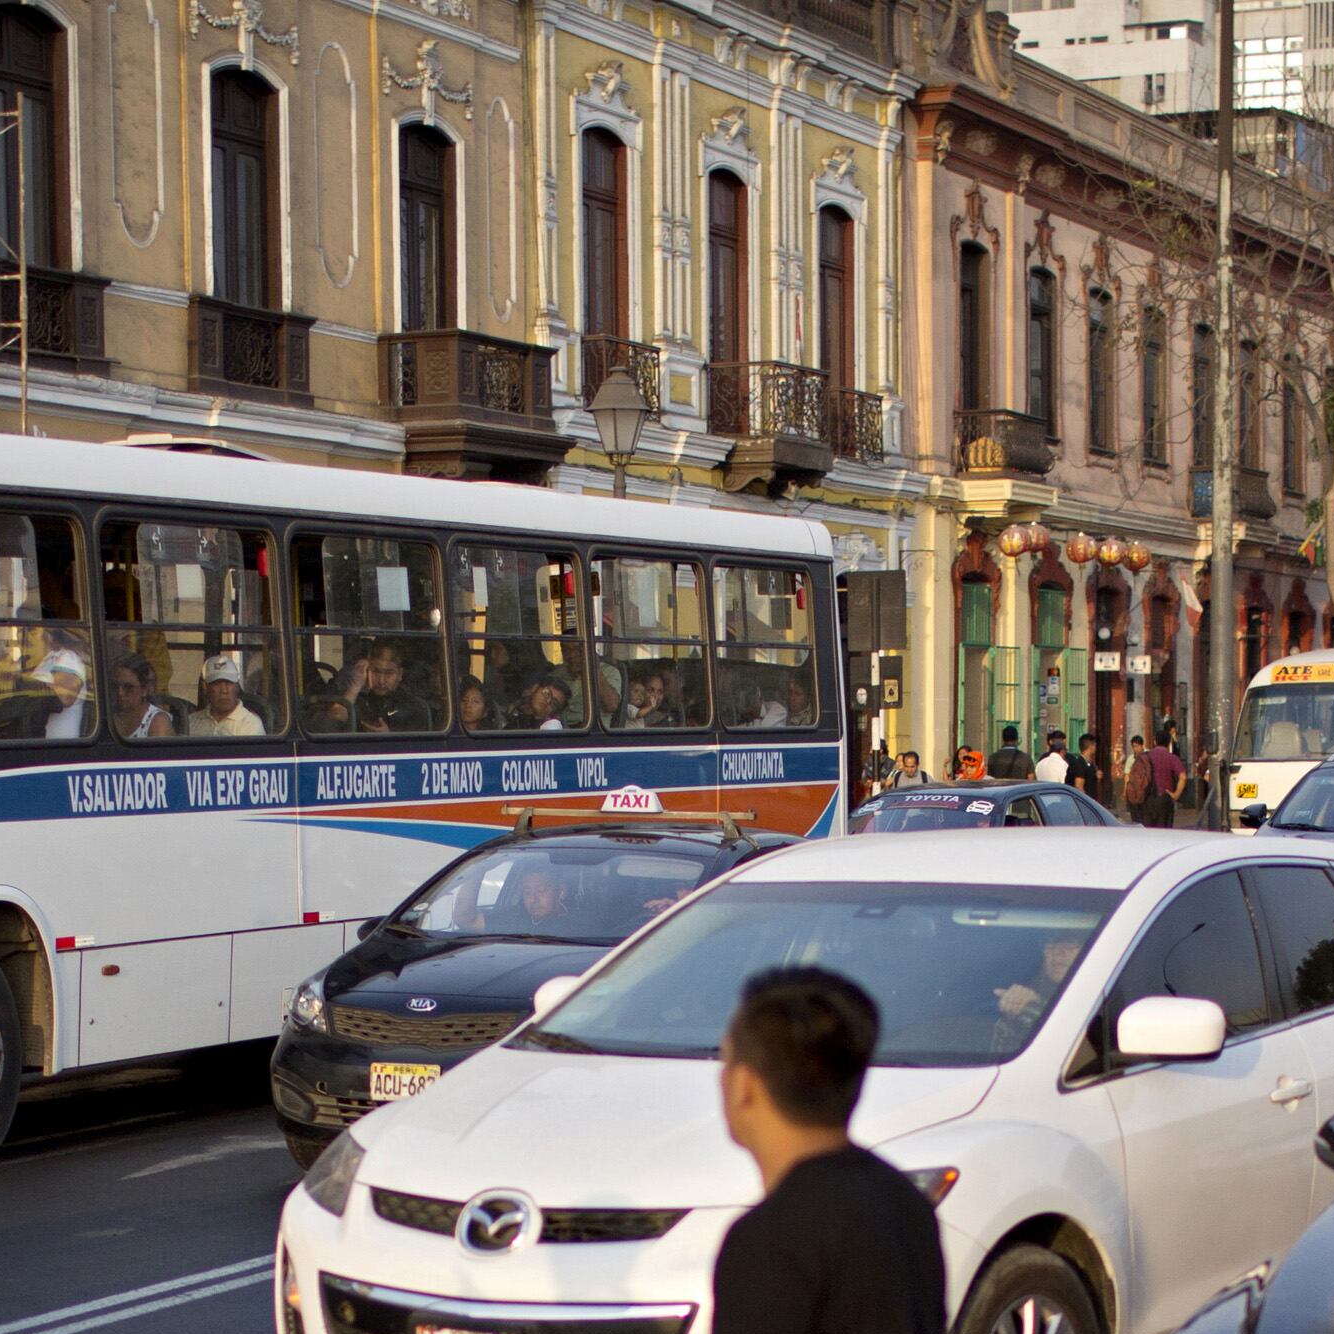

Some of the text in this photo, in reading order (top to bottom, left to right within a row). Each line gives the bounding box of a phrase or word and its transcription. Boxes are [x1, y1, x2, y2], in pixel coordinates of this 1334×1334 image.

[1277, 665, 1313, 675] ATE
[317, 760, 483, 800] ALF.UGARTE 2 DE MAYO
[501, 757, 609, 792] COLONIAL VIPOL
[722, 752, 785, 781] CHUQUITANTA
[68, 769, 289, 813] V.SALVADOR VIA EXP GRAU
[611, 794, 650, 808] TAXI
[410, 998, 432, 1009] KIA
